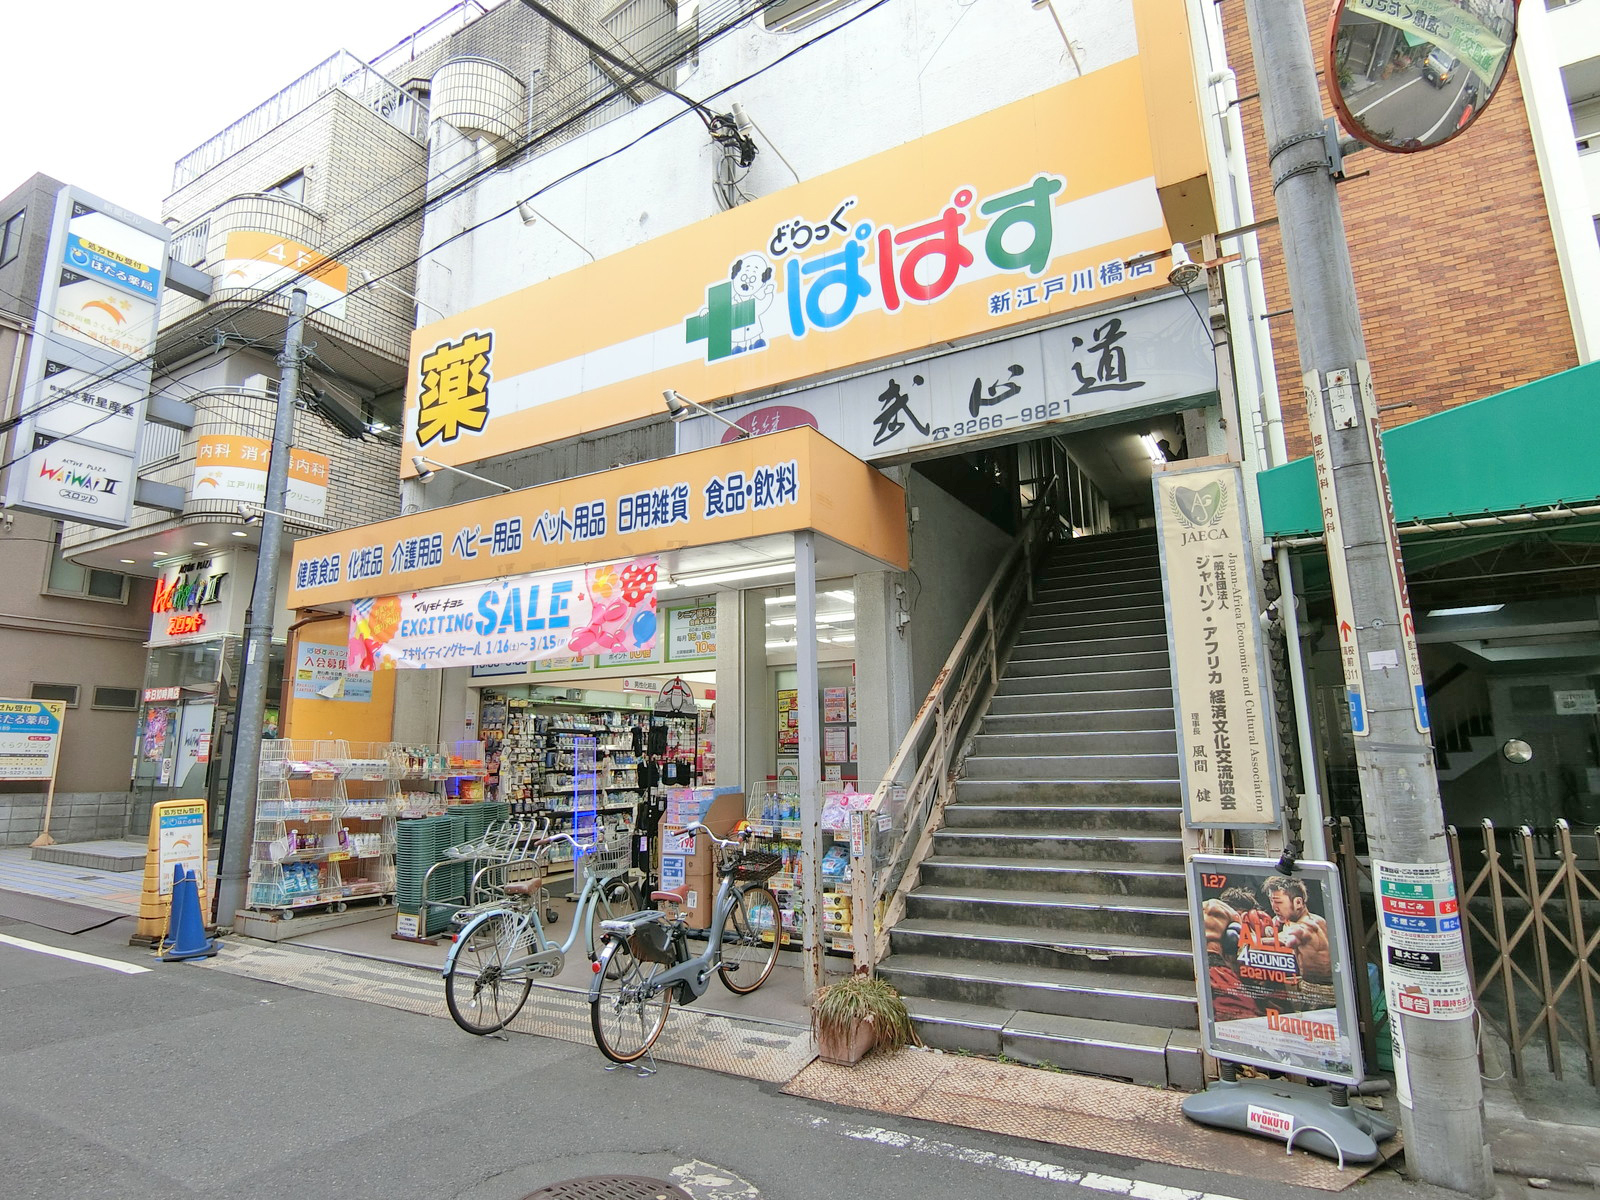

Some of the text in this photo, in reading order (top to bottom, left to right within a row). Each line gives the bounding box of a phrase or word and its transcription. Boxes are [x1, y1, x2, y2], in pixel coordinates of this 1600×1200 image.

[74, 204, 86, 215] 5F
[770, 201, 854, 255] どらっぐ
[88, 242, 142, 270] 処方せん受付
[268, 244, 312, 268] 4F
[787, 176, 1061, 336] ぱぱす
[64, 272, 78, 281] 4F
[91, 260, 153, 292] ほたる薬局
[990, 254, 1153, 315] 新江戸川橋店
[48, 364, 60, 373] 3F
[415, 332, 494, 447] 薬
[82, 392, 134, 417] 新星産業
[953, 399, 1072, 438] 3266-9821
[38, 436, 50, 446] 1F
[200, 444, 232, 458] 内科
[63, 490, 96, 503] スロット
[1313, 434, 1336, 533] 整形外科・内科
[296, 462, 797, 589] 健康食品 化粧品 介護用品 ベビー用品 ペット用品 日用雑貨 食品・飲料
[1181, 528, 1230, 546] JAECA
[1212, 554, 1230, 610] 一般社団法人
[401, 612, 474, 638] EXCITING
[476, 581, 574, 636] SALE
[414, 598, 464, 612] マツモトキヨシ
[304, 656, 347, 670] 入会募集
[399, 639, 482, 660] エキサイティングセール
[1196, 554, 1236, 810] ジャパン・アフリカ 経済文化交流協会
[1228, 552, 1264, 812] Japan-Africa Economic and Cultural Association
[1190, 712, 1212, 803] 理事長 風間 健
[164, 808, 200, 816] 処方せん受付
[1202, 873, 1227, 888] 1.27
[1237, 923, 1294, 954] ALL
[1266, 1007, 1336, 1042] Dangan
[1250, 1112, 1290, 1130] KYOKUTO
